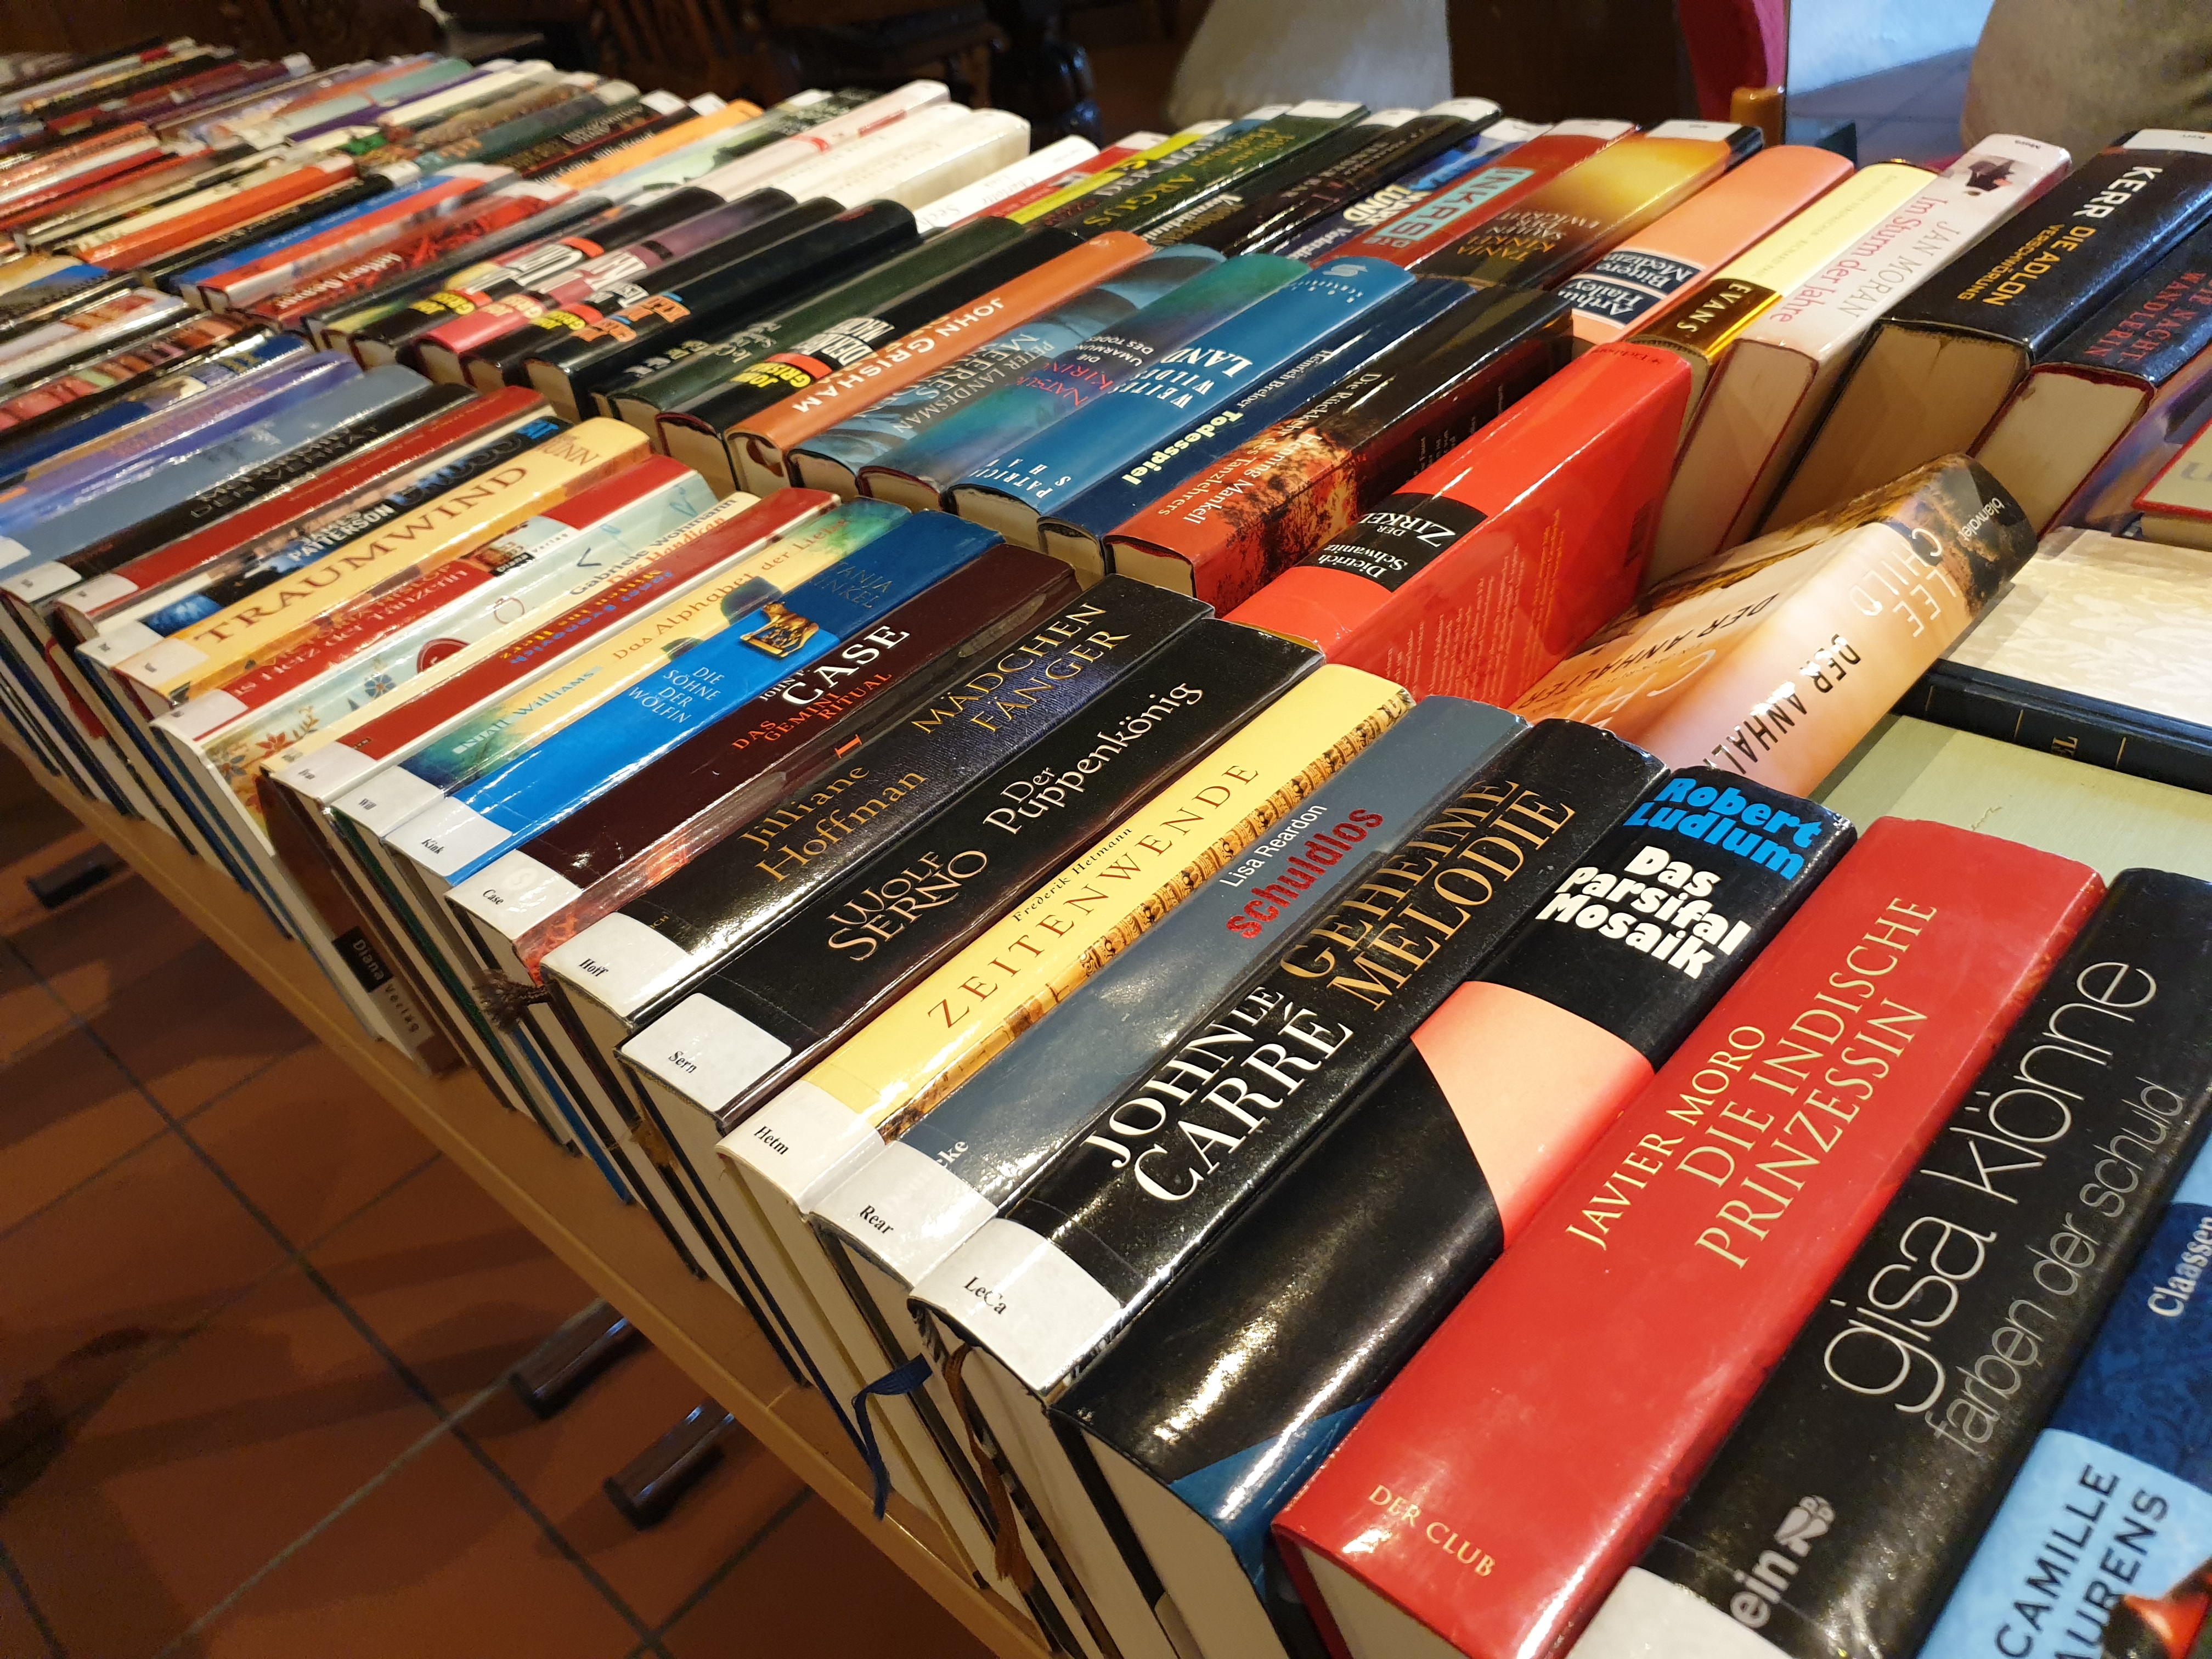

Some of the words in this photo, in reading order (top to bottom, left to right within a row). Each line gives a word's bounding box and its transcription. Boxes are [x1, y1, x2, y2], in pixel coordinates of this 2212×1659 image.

[1342, 183, 1410, 221] LUND
[1905, 196, 1949, 219] Im
[2073, 166, 2163, 219] KERR
[1862, 216, 1922, 257] Sturm
[1912, 221, 1961, 258] JAN
[1957, 224, 2065, 302] VERSCHWÖRUNG
[2052, 225, 2097, 252] DIE
[1575, 278, 1644, 306] Hailey
[1821, 259, 1867, 284] der
[1838, 256, 1923, 318] MORAN
[1982, 251, 2061, 307] ADLON
[935, 296, 1005, 338] JOHN
[1677, 281, 1752, 332] EVANS
[1770, 284, 1836, 324] Jahre
[916, 333, 1041, 401] MEERES
[1002, 339, 1055, 370] PETER
[1125, 338, 1155, 356] DES
[1160, 347, 1254, 379] LAND
[1280, 348, 1334, 383] Heinrich
[792, 337, 935, 414] GRISHAM
[893, 368, 1006, 435] LANDESMAN
[1041, 360, 1114, 392] KIRIN
[1238, 377, 1284, 408] Breloer
[1359, 373, 1383, 391] Die
[1280, 387, 1357, 440] Rückkehr
[1122, 410, 1244, 485] Todesspiel
[1244, 432, 1323, 478] Henning
[1248, 435, 1279, 460] des
[1158, 455, 1257, 517] Tanzlehrers
[1182, 476, 1255, 524] Mankell
[289, 503, 395, 562] PATTERSON
[1359, 511, 1457, 548] ZIRKEL
[1376, 525, 1406, 538] DER
[1956, 496, 2006, 543] blanvalet
[194, 466, 528, 644] TRAUMWIND
[570, 549, 650, 595] Gabriele
[1318, 553, 1387, 579] Dietrich
[1324, 543, 1410, 572] Schwanitz
[1849, 527, 1943, 618] CHILD
[612, 635, 653, 661] Das
[656, 572, 754, 635] Alphabet
[761, 551, 791, 572] der
[796, 518, 848, 551] Liebe
[1697, 592, 1780, 639] DER
[1892, 568, 1957, 638] LEE
[662, 669, 721, 702] SÖHNE
[692, 665, 725, 685] DIE
[759, 674, 795, 702] JOHN
[782, 625, 910, 706] CASE
[911, 602, 1108, 734] MÄDCHEN
[970, 628, 1132, 732] FÄNGER
[1519, 628, 1694, 712] ANHALTER
[1799, 633, 1862, 694] DER
[629, 686, 693, 725] WÖLFIN
[659, 686, 693, 708] DER
[764, 692, 841, 741] GEMINI
[817, 673, 892, 721] RITUAL
[731, 720, 778, 751] DAS
[1702, 679, 1808, 775] ANHAL
[982, 682, 1204, 834] Puppenkönig
[358, 798, 377, 811] Will
[740, 767, 871, 852] Jilliane
[1000, 767, 1053, 804] Der
[756, 771, 928, 882] Hoffman
[1653, 776, 1824, 849] Robert
[421, 837, 445, 855] Kink
[1219, 853, 1267, 888] Lisa
[1261, 804, 1328, 867] Reardon
[1624, 802, 1806, 881] Ludlum
[483, 888, 504, 906] Case
[828, 850, 944, 928] WOLF
[927, 764, 1260, 1029] ZEITENWENDE
[1012, 876, 1071, 922] Frederik
[1072, 826, 1134, 875] Hetmann
[1225, 806, 1384, 939] schuldlos
[1279, 779, 1520, 980] GEHEIME
[1624, 845, 1723, 898] Das
[827, 850, 988, 962] SERNO
[1326, 789, 1577, 1011] MELODIE
[1554, 866, 1752, 957] Parsifal
[352, 939, 384, 981] Diana
[1534, 893, 1715, 980] Mosaik
[578, 958, 609, 978] Hoff
[385, 984, 421, 1033] Verlag
[668, 1050, 697, 1074] Sern
[1675, 1099, 1775, 1188] DIE
[1750, 896, 1938, 1096] INDISCHE
[1079, 1020, 1256, 1169] JOHN
[1235, 986, 1285, 1039] LE
[1134, 1002, 1354, 1201] CARRÉ
[754, 1125, 790, 1155] Hetm
[1566, 1133, 1684, 1251] JAVIER
[1667, 1025, 1766, 1127] MORO
[1694, 997, 1928, 1269] PRINZESSIN
[1824, 1215, 1997, 1415] gisa
[1920, 961, 2157, 1205] klönne
[859, 1204, 894, 1234] Rear
[1925, 1297, 2058, 1455] farben
[2025, 1211, 2102, 1297] der
[2078, 1077, 2185, 1218] schuld
[963, 1276, 1008, 1315] LeCa
[1368, 1484, 1424, 1528] DER
[1425, 1520, 1497, 1578] CLUB
[1995, 1464, 2121, 1659] CAMILLE
[2053, 1488, 2171, 1659] AURENS
